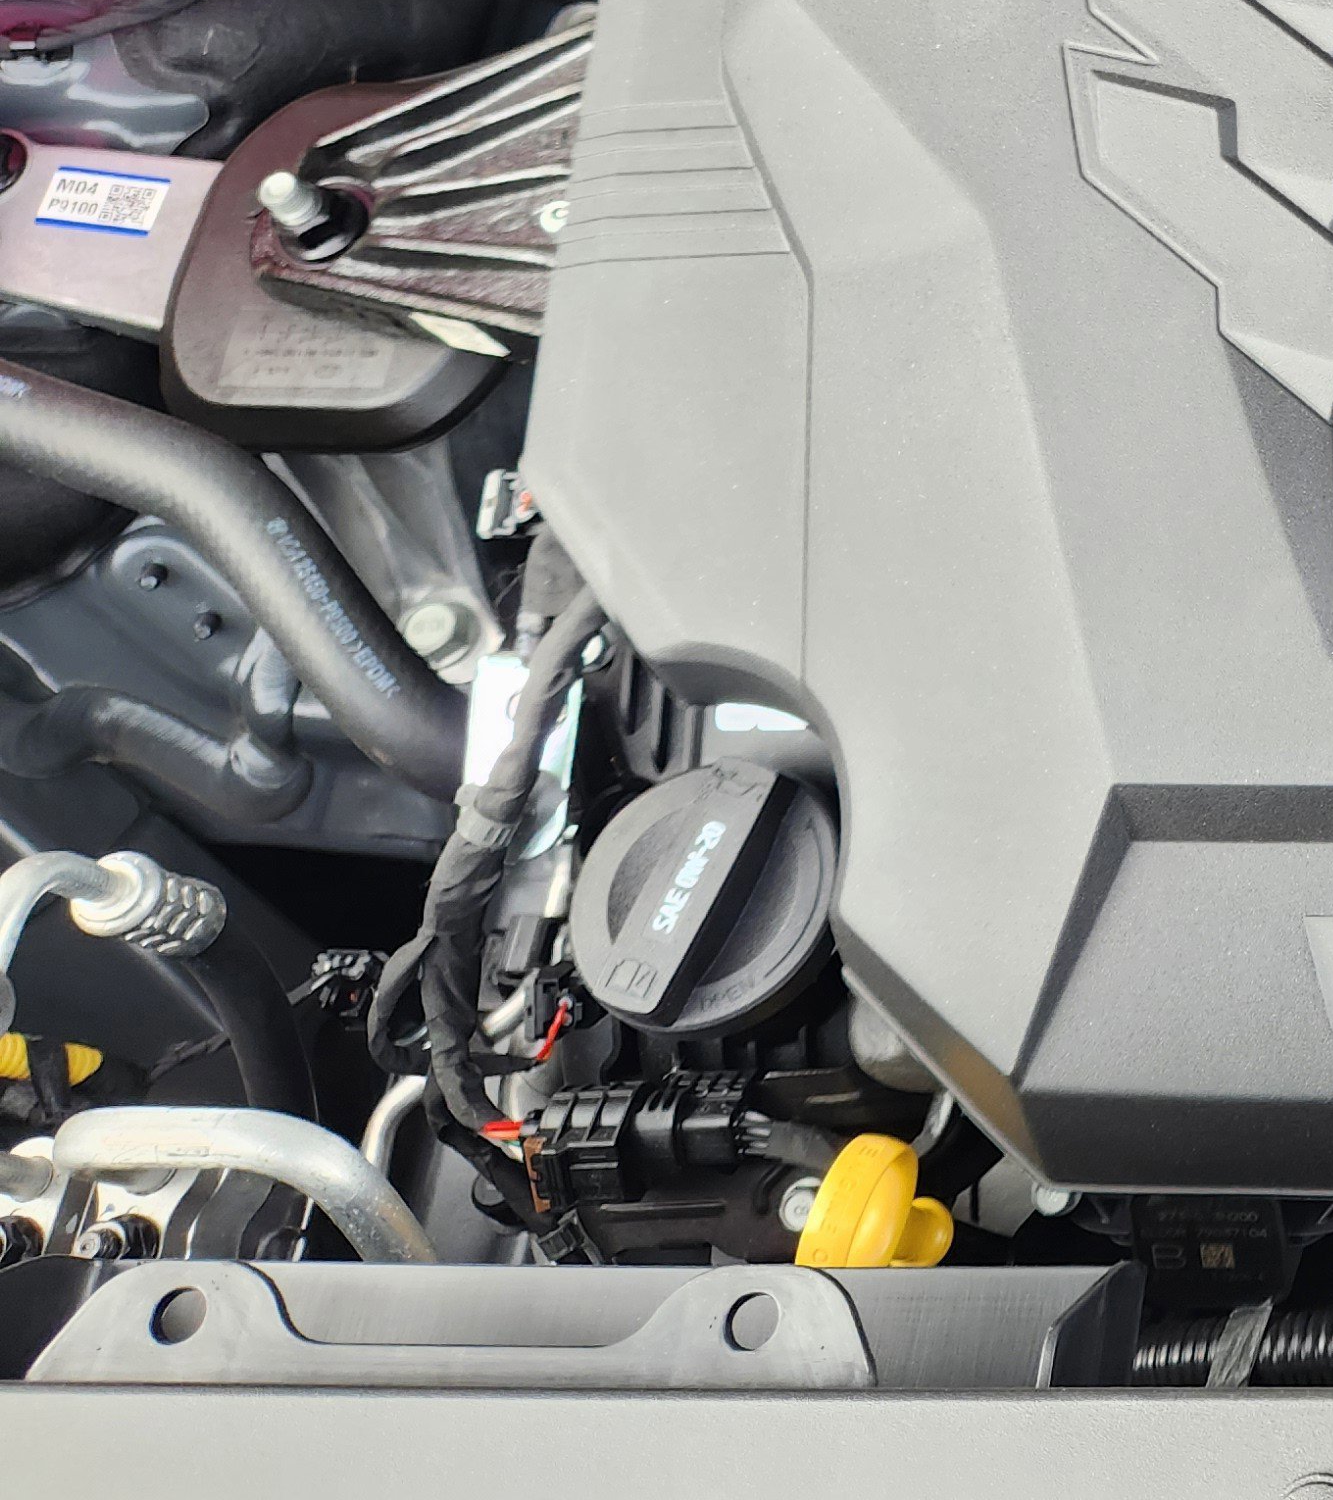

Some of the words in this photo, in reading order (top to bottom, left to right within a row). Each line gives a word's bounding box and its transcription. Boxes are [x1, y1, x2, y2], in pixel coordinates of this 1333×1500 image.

[56, 178, 99, 196] M04
[47, 197, 99, 217] P9100
[652, 886, 693, 935] SAE
[674, 820, 727, 890] 0W-20
